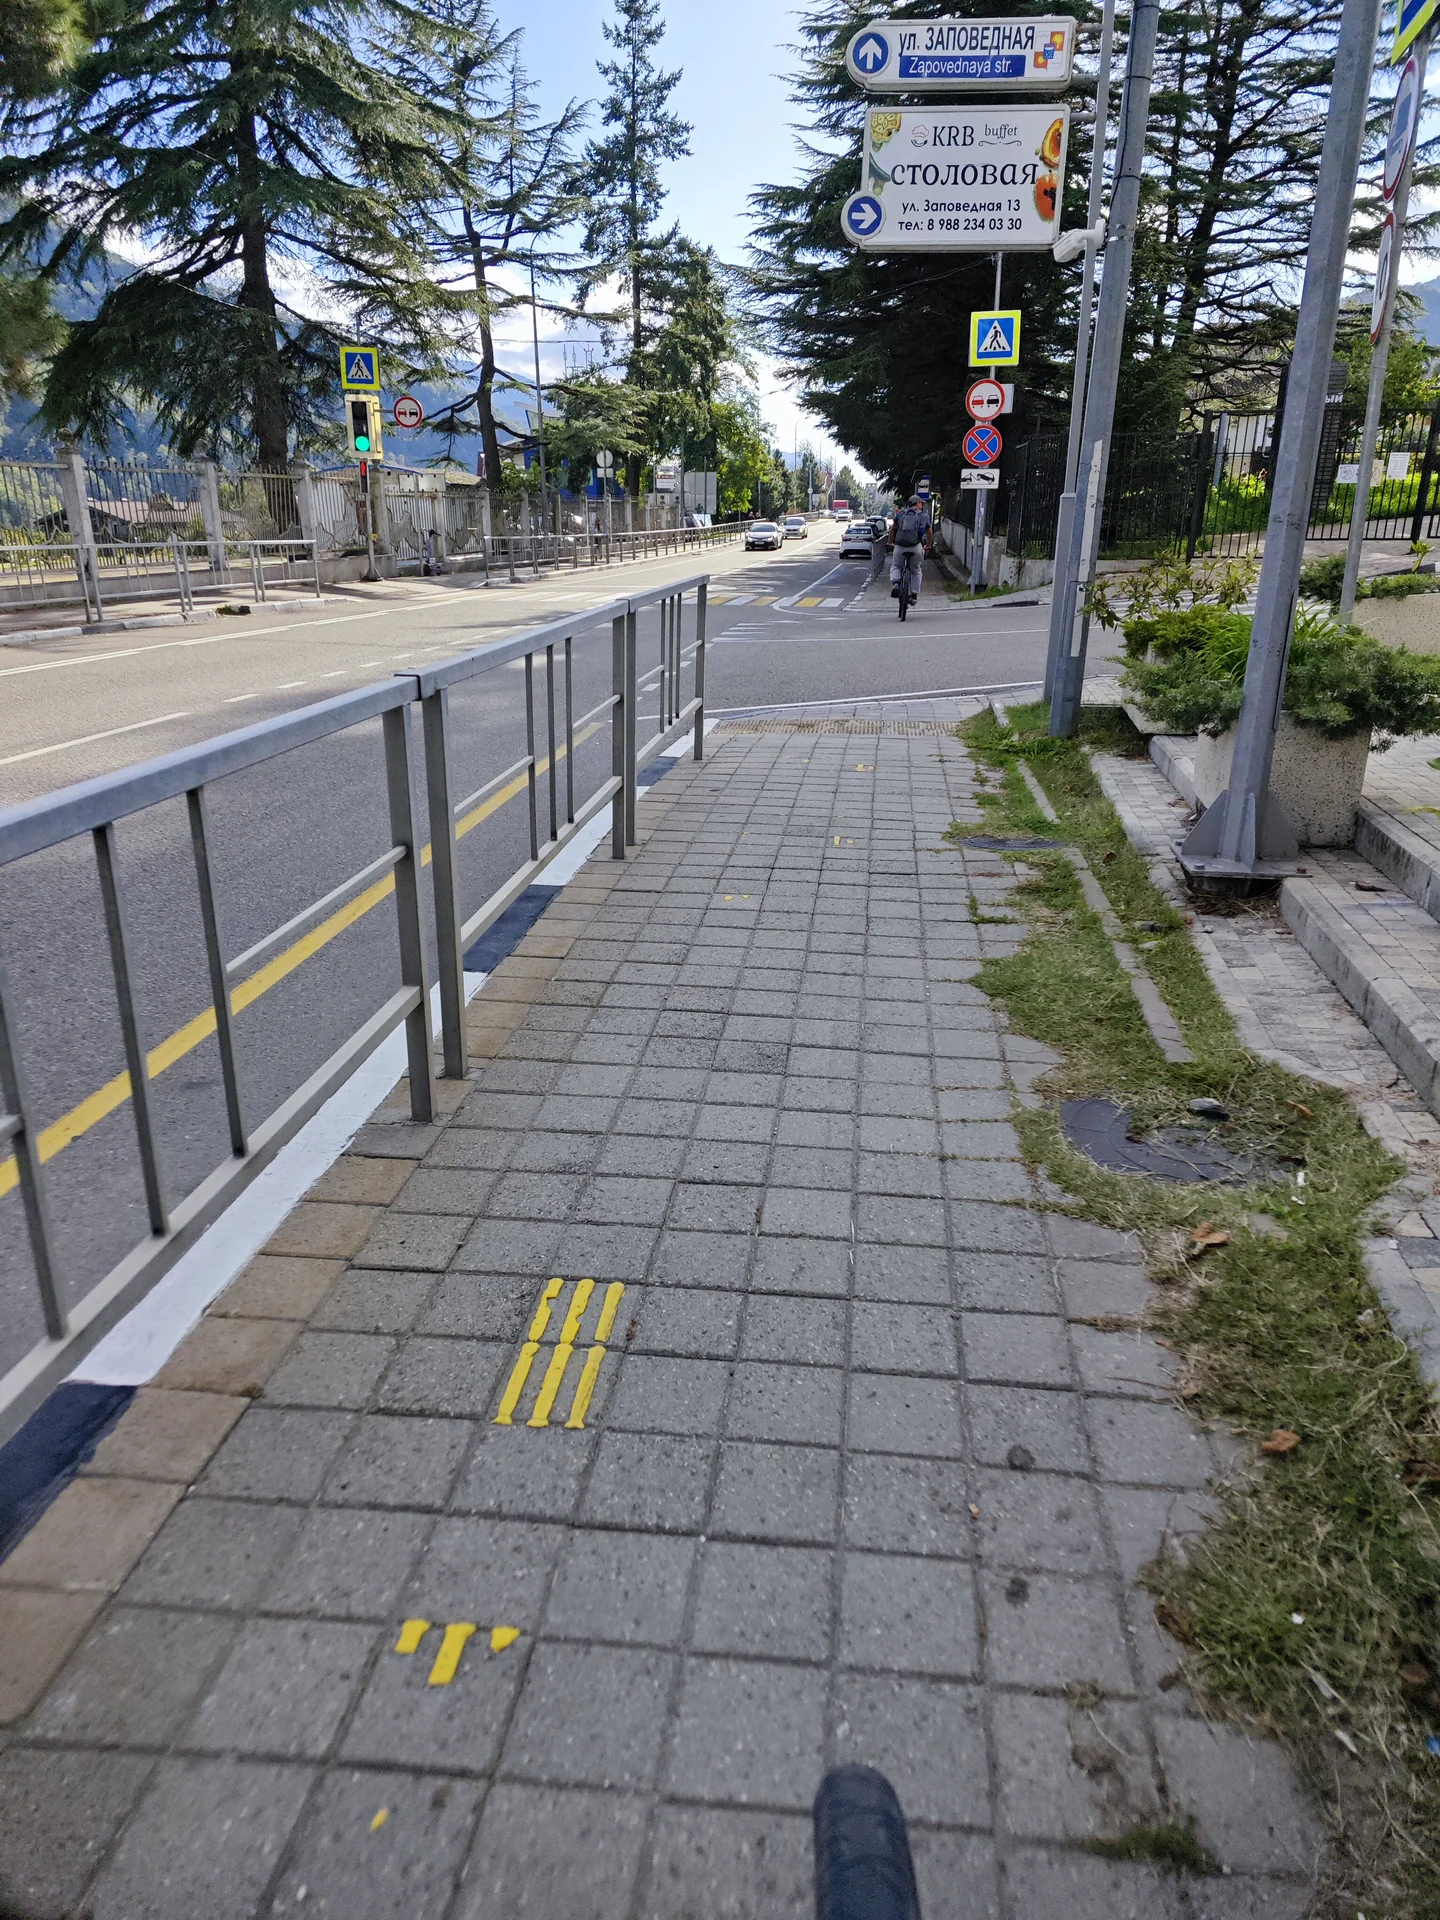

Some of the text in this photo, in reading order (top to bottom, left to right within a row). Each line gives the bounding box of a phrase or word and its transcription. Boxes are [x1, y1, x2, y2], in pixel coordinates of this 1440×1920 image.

[899, 26, 1035, 57] ул. ЗАПОВЕДНАЯ
[909, 57, 1013, 77] Zapovednaya str.
[931, 123, 1018, 147] KRB buffet
[902, 199, 1021, 214] ул. Заповедная 13
[898, 218, 1022, 231] тел: 8 988 234 03 30
